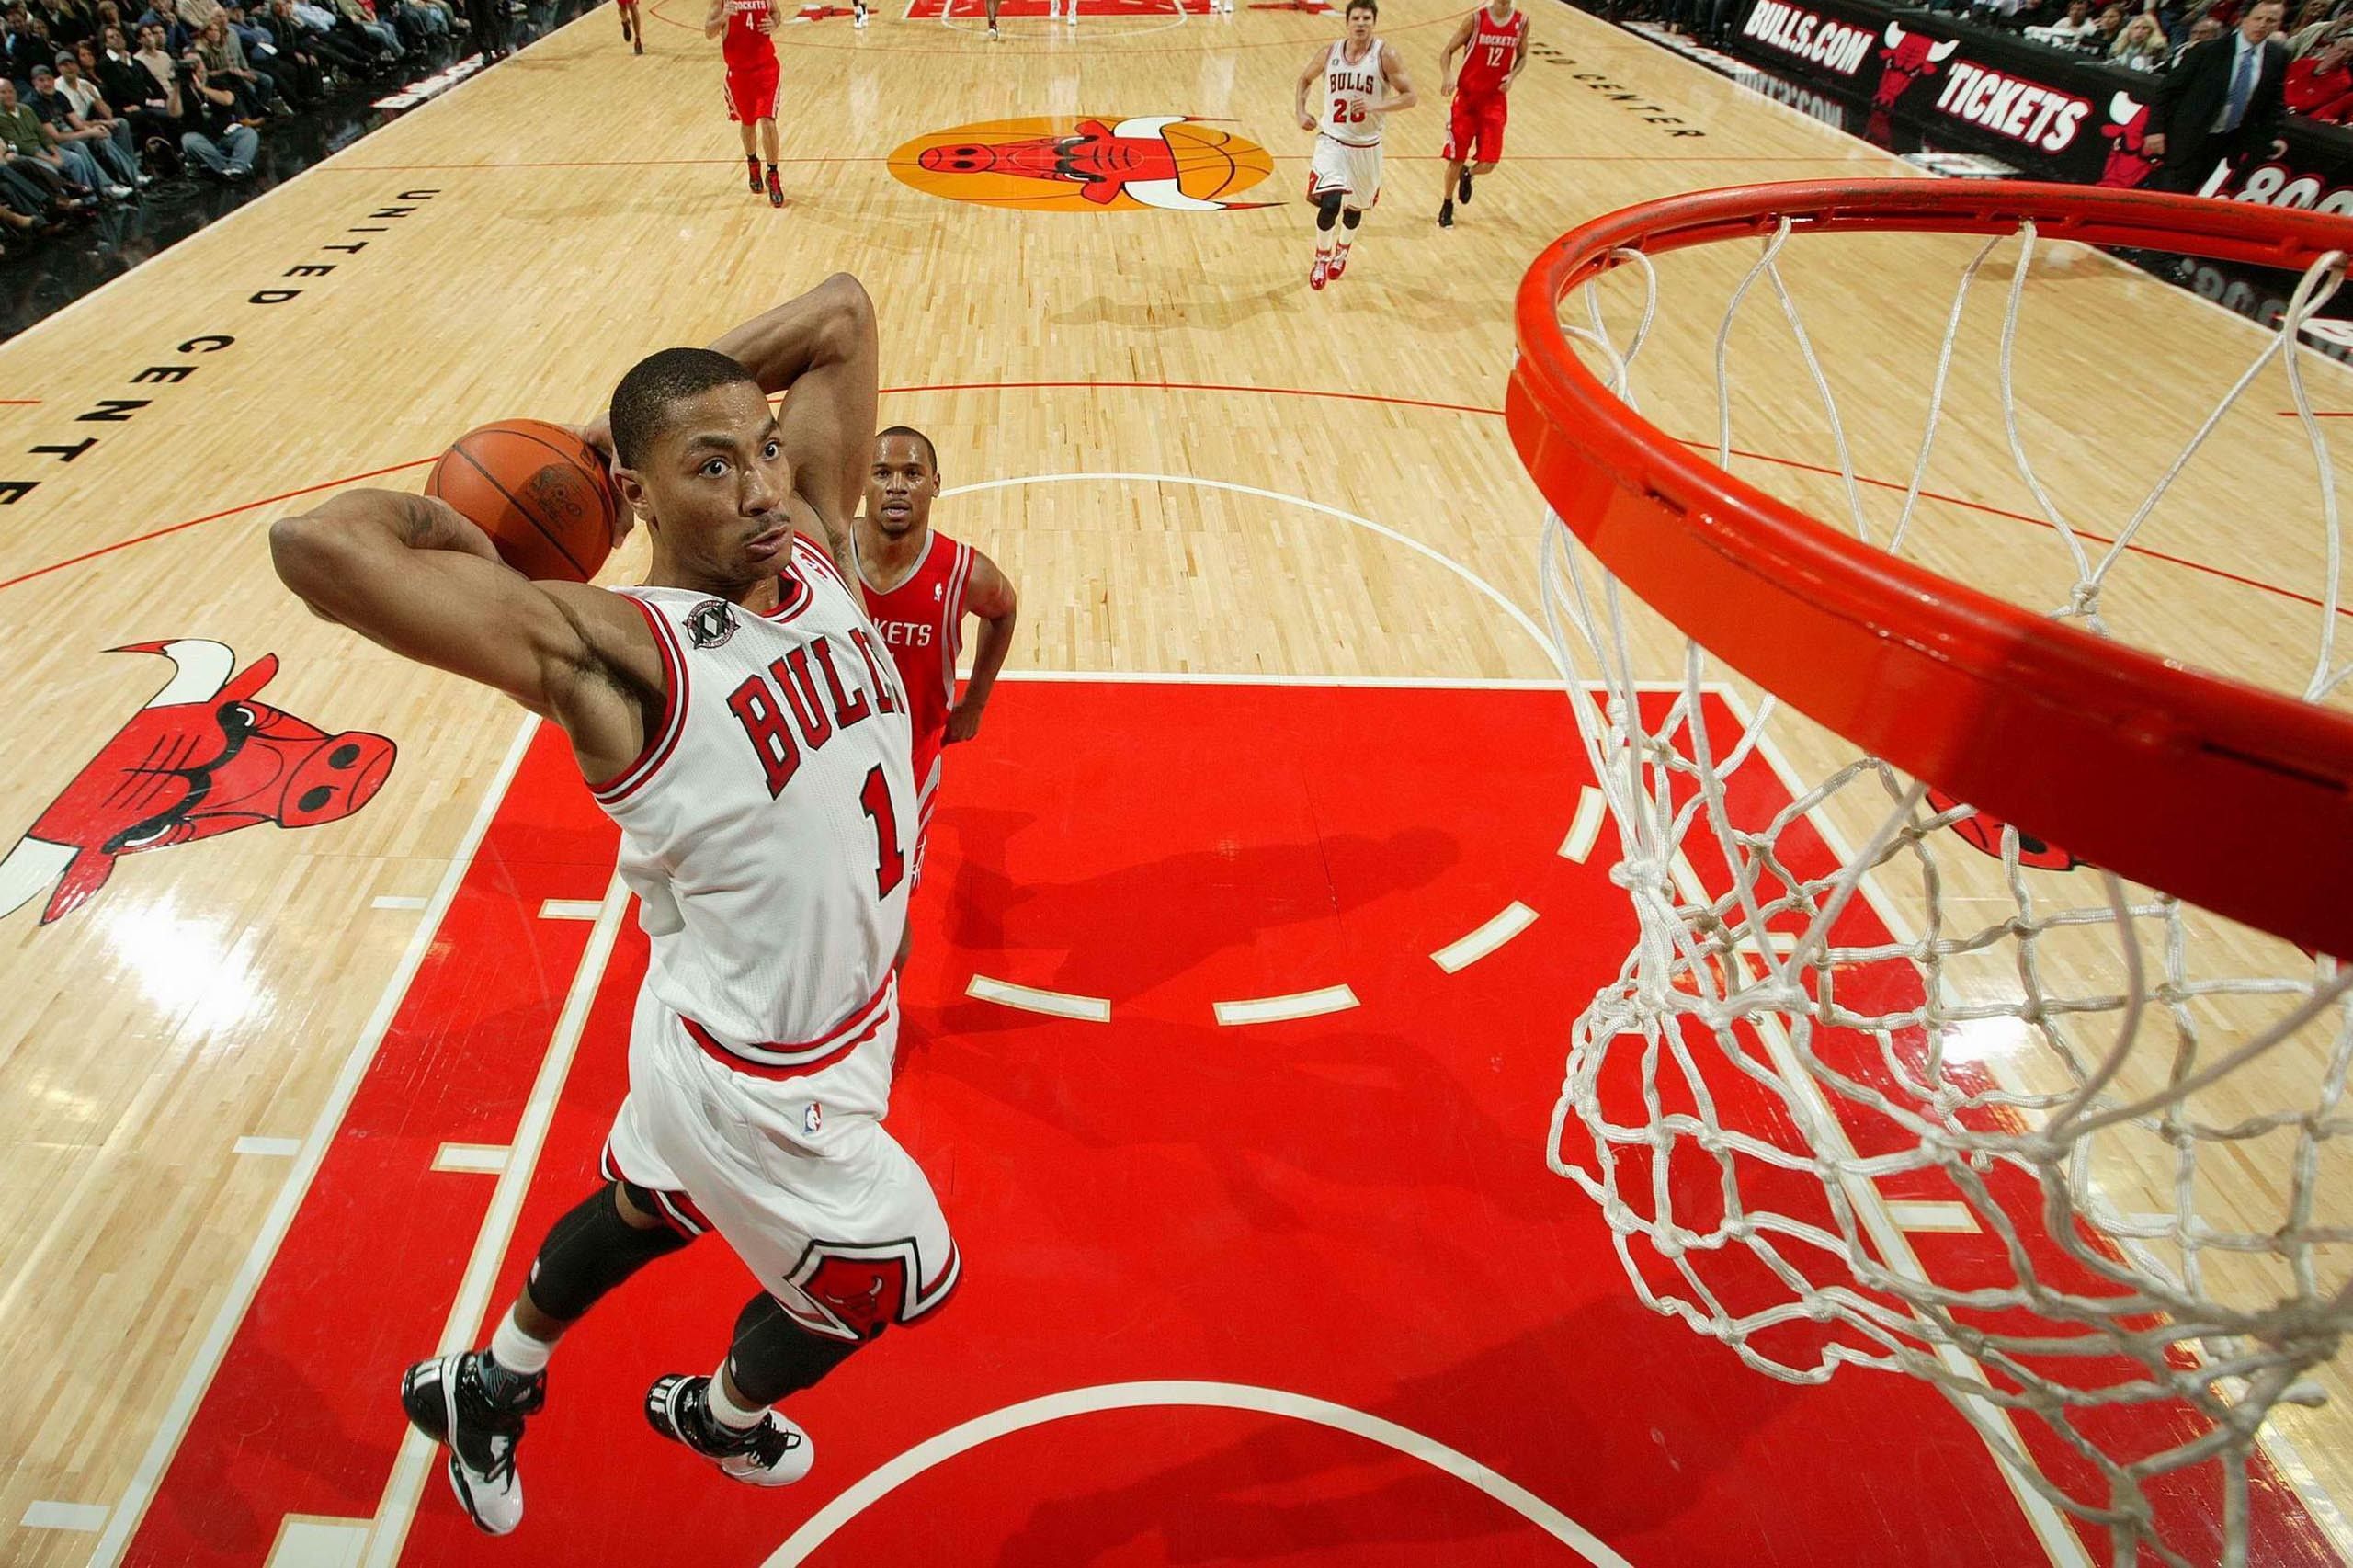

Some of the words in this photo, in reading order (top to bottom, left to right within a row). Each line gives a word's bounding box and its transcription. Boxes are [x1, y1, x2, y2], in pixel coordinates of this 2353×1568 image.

[736, 0, 767, 10] OCKETS
[745, 12, 754, 30] 4
[1479, 33, 1518, 48] ROCKETS
[1486, 47, 1504, 66] 12
[1743, 0, 1875, 74] BULLS.COM
[1330, 73, 1374, 95] BULLS
[1572, 74, 1707, 137] CENTER
[1935, 62, 2090, 152] TICKETS
[246, 189, 442, 305] UNITED
[0, 335, 235, 505] CENTE
[873, 617, 932, 646] KETS
[725, 627, 905, 801] BULL
[859, 762, 904, 903] 1
